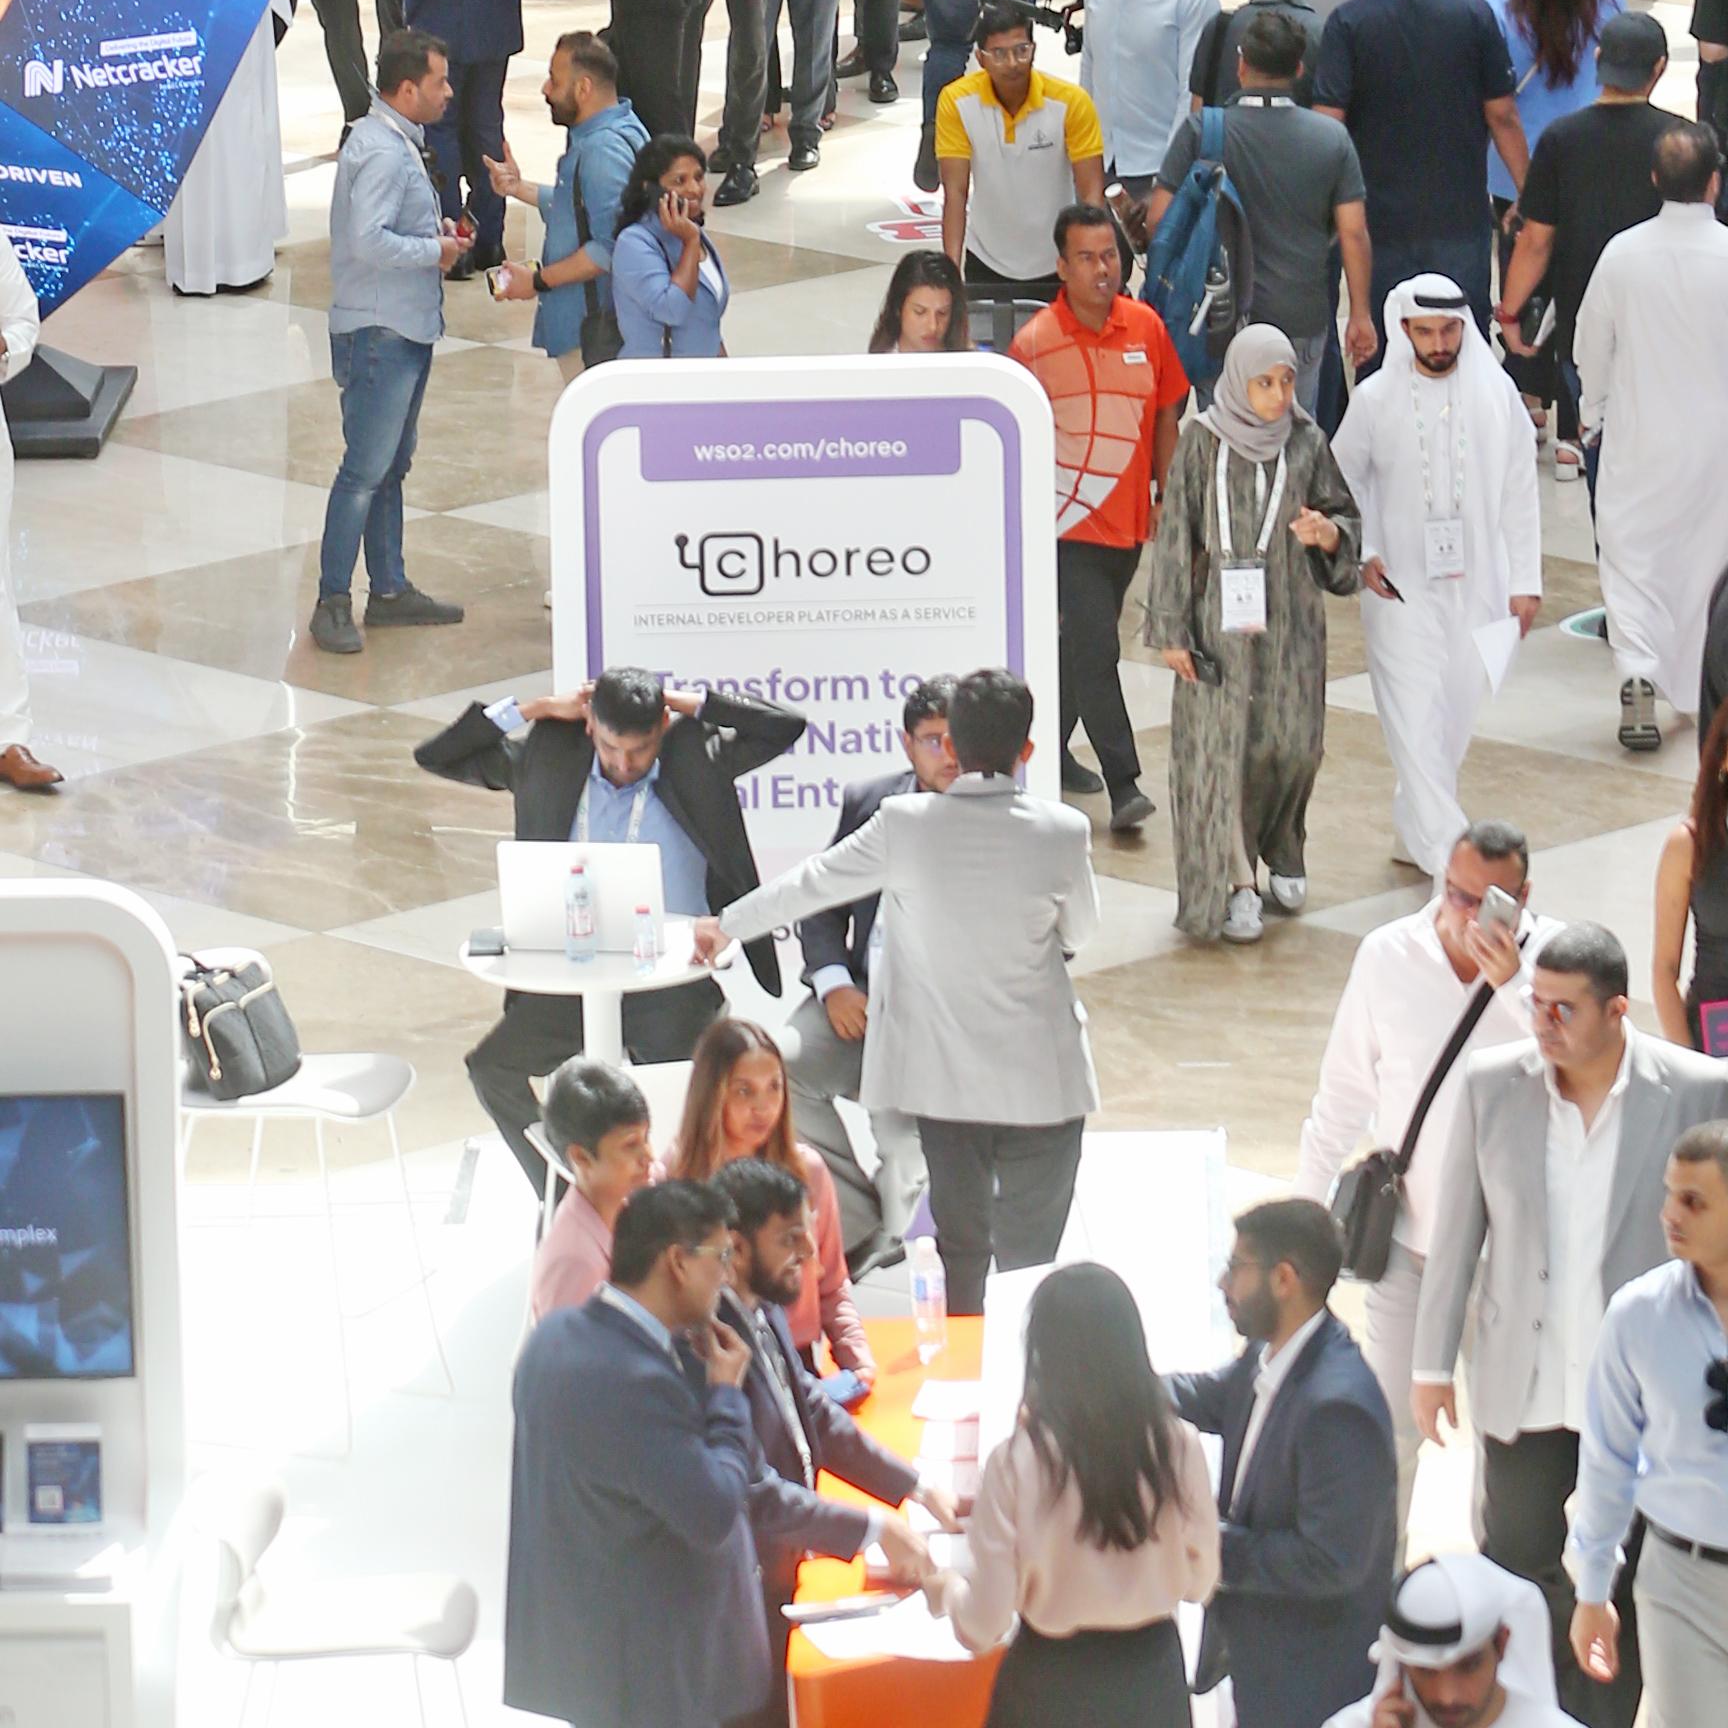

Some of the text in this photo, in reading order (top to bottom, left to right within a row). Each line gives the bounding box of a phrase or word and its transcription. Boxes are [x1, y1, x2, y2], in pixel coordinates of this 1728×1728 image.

[71, 54, 204, 92] Netcracker
[693, 436, 908, 462] wso2.com/choreo
[633, 605, 977, 629] INTERNAL DEVELOPER PLATFORM AS A SERVICE
